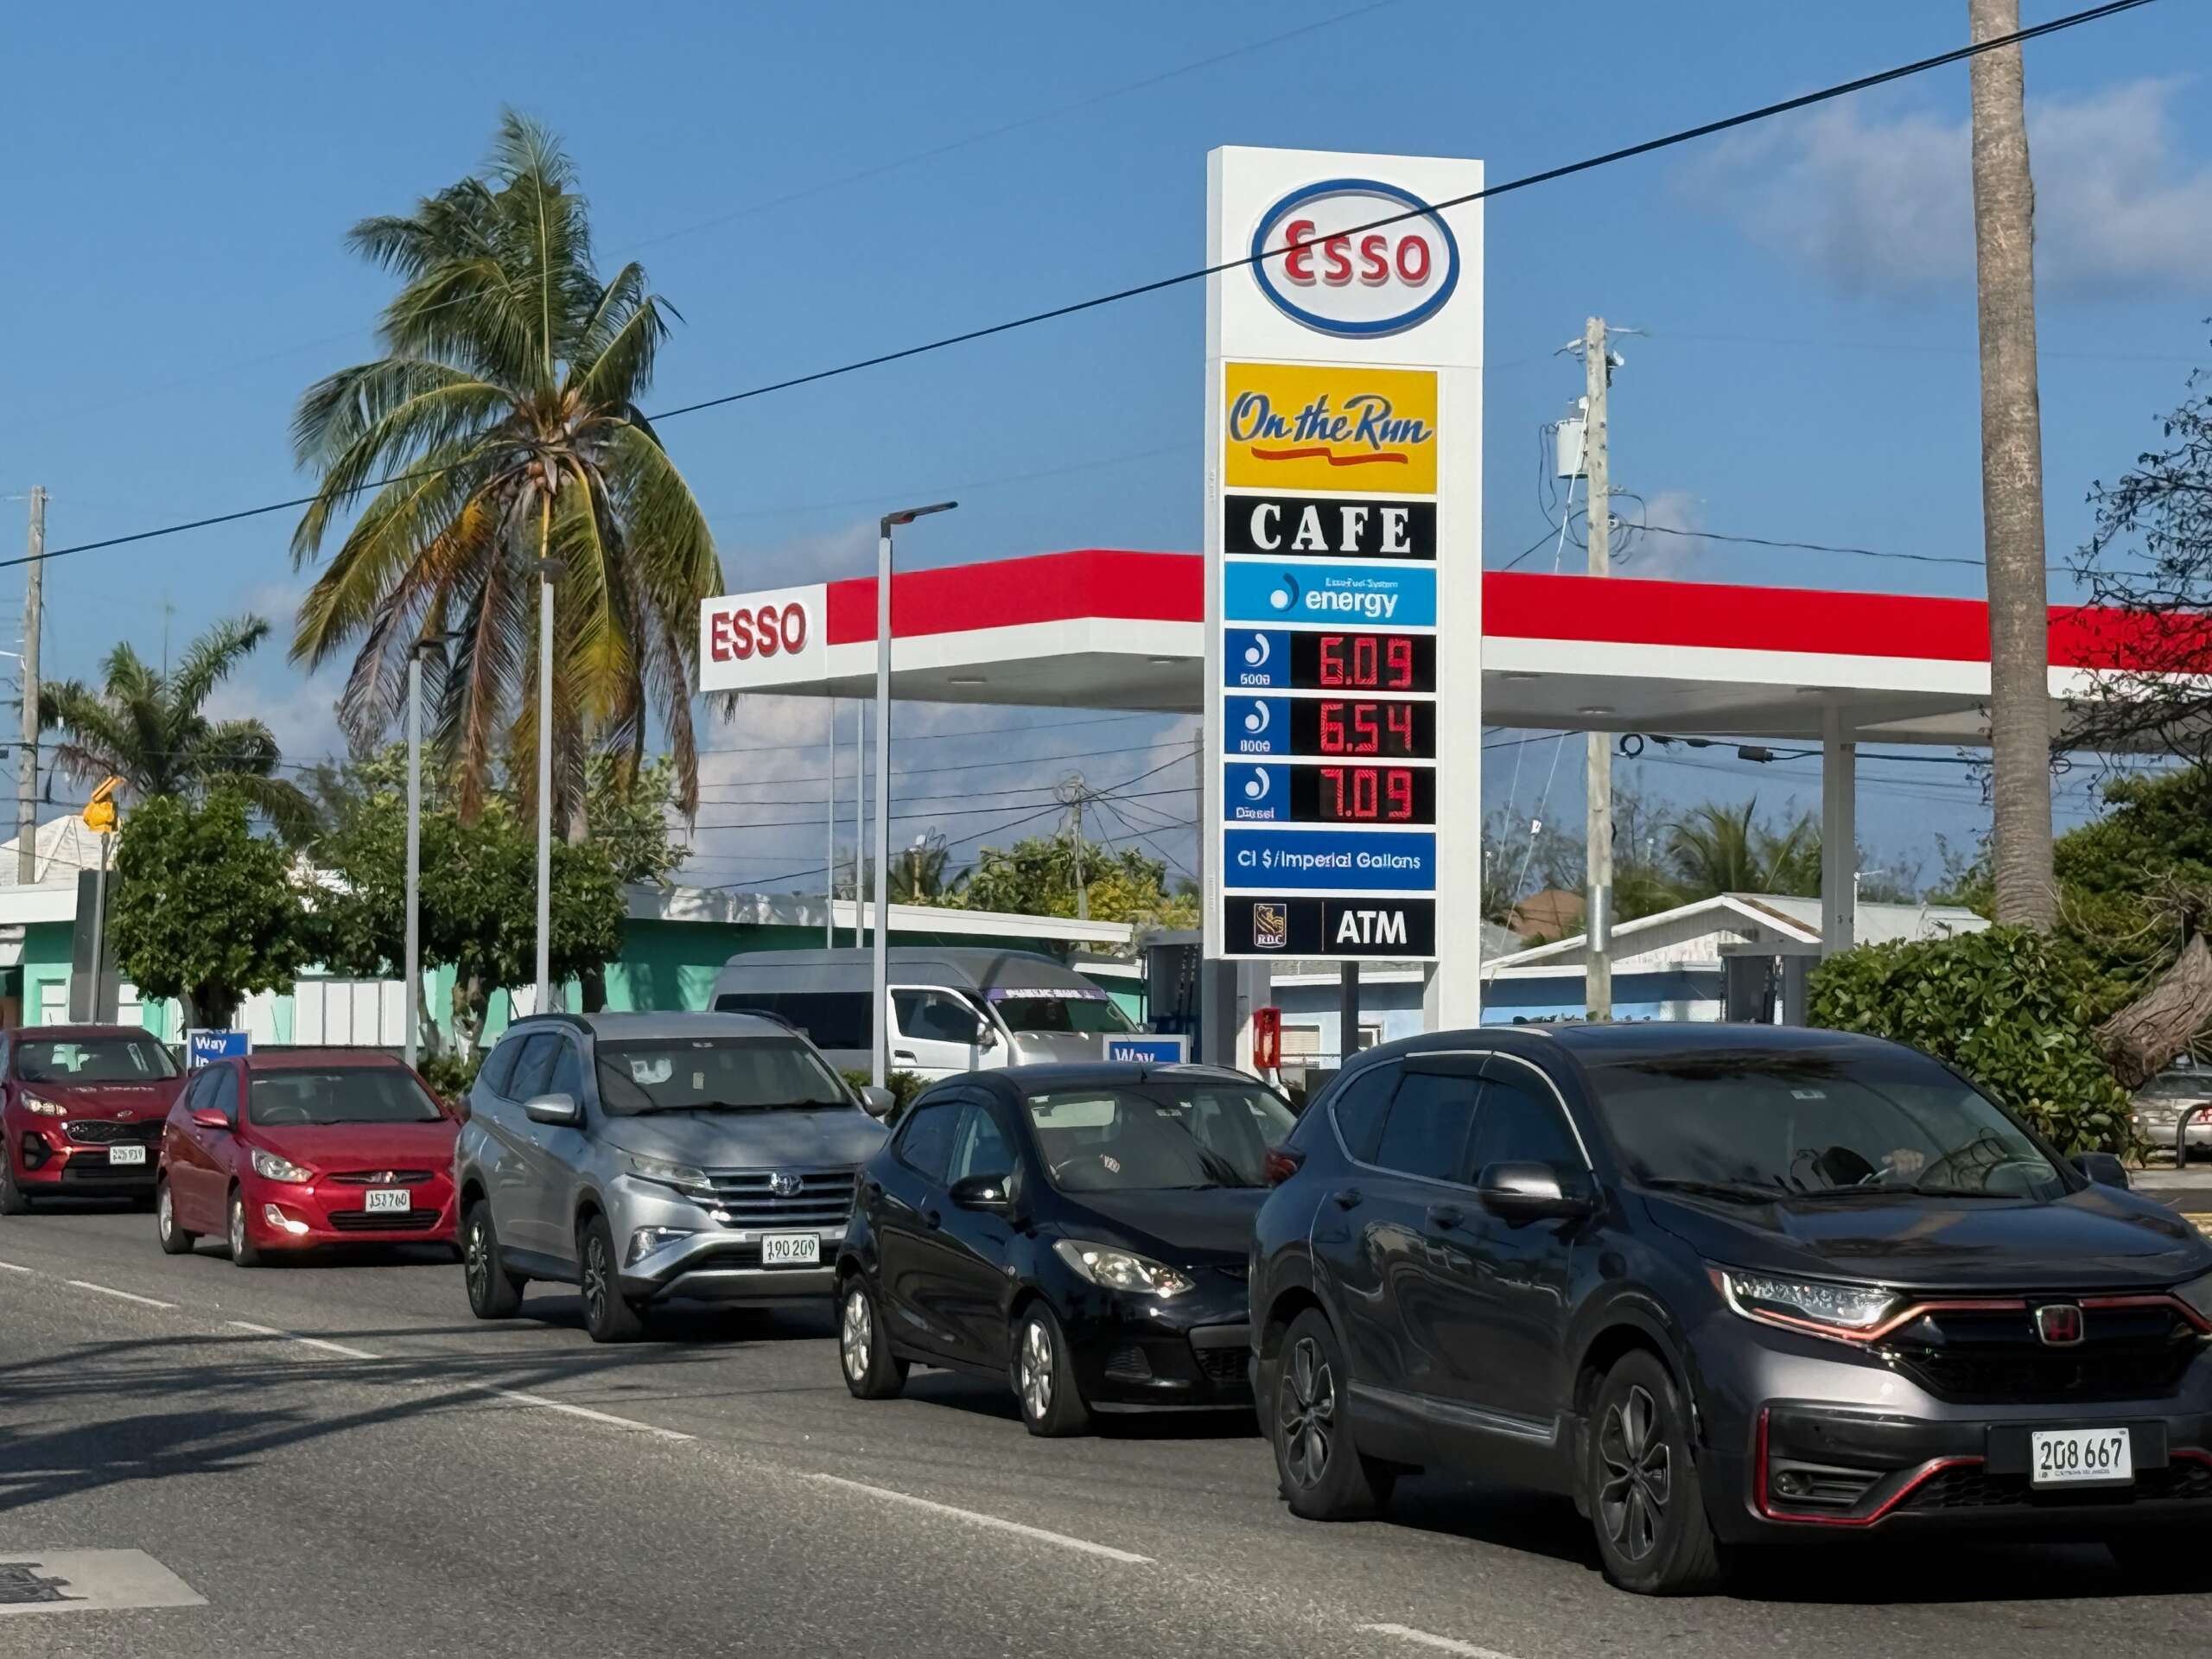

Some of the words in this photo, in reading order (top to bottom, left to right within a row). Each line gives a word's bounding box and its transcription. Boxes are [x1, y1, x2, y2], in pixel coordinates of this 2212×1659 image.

[1230, 391, 1293, 442] On
[1292, 394, 1354, 442] the
[1343, 394, 1433, 451] Run
[1249, 503, 1412, 553] CAFE
[1306, 590, 1399, 619] energy
[711, 602, 808, 663] ESSO
[1319, 637, 1413, 688] 6.09
[1319, 702, 1413, 753] 6.54
[1319, 768, 1413, 819] 7.09
[1236, 807, 1275, 819] Diesel
[1357, 852, 1421, 870] Gallons
[1336, 910, 1408, 945] ATM
[195, 1036, 227, 1054] Way
[767, 1240, 790, 1259] 190
[792, 1239, 815, 1256] 209
[2040, 1440, 2079, 1471] 208
[2084, 1438, 2122, 1468] 667
